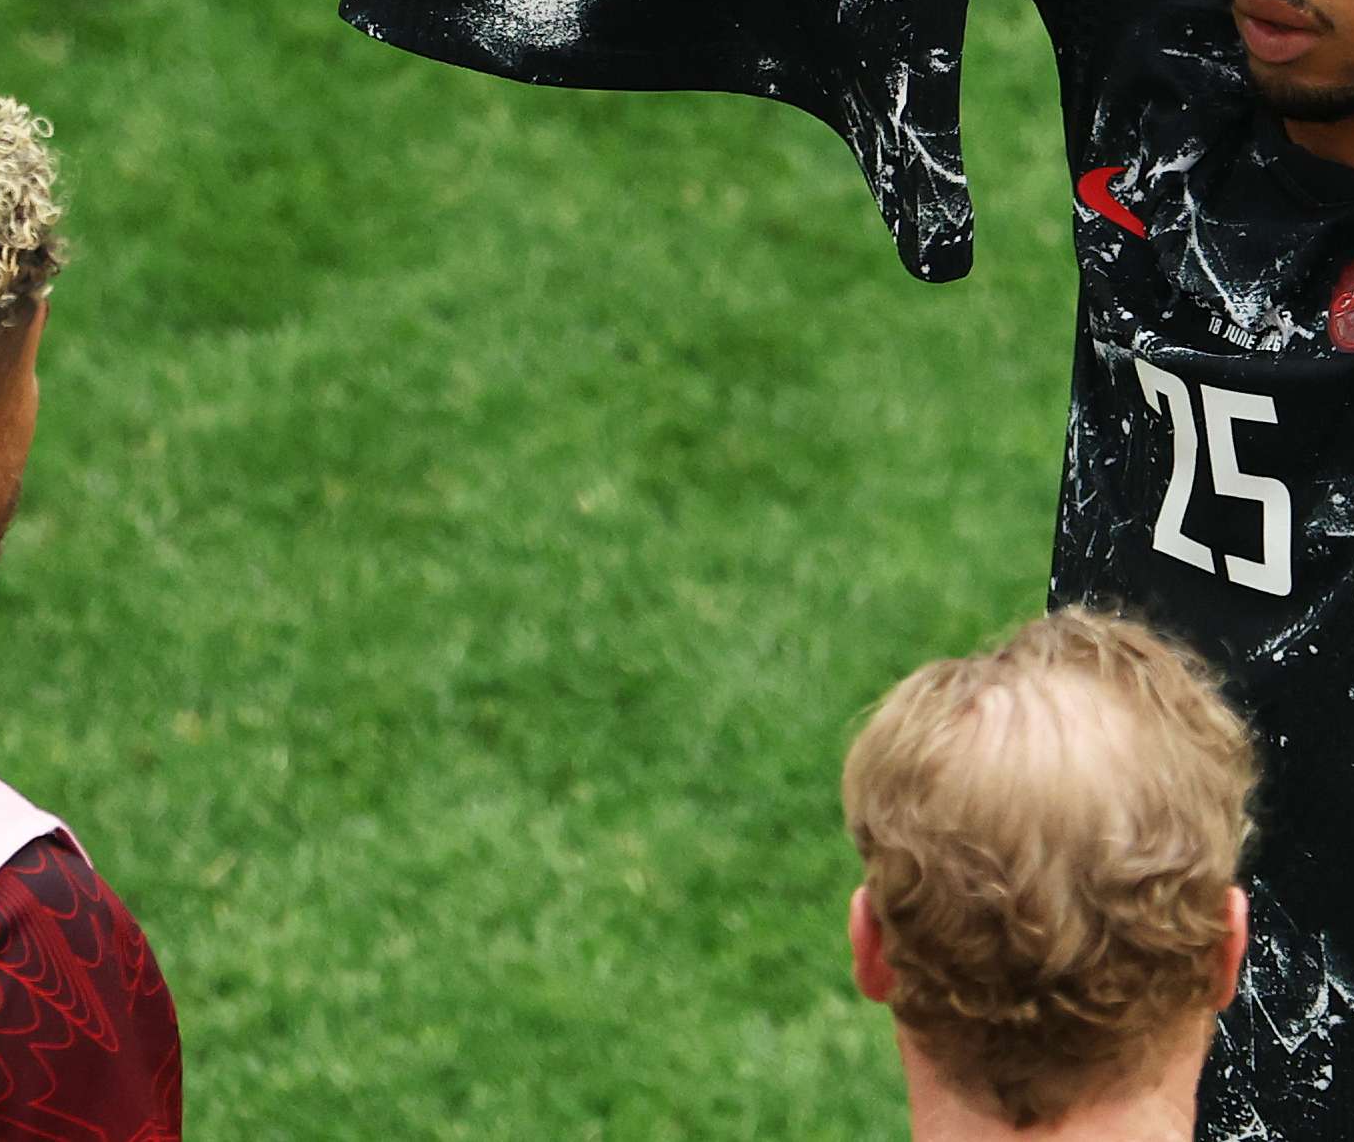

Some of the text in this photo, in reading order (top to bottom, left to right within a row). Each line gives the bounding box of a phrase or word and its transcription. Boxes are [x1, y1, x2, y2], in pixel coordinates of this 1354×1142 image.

[1208, 316, 1223, 335] 18
[1222, 323, 1258, 350] JUNE
[1134, 357, 1293, 597] 25
